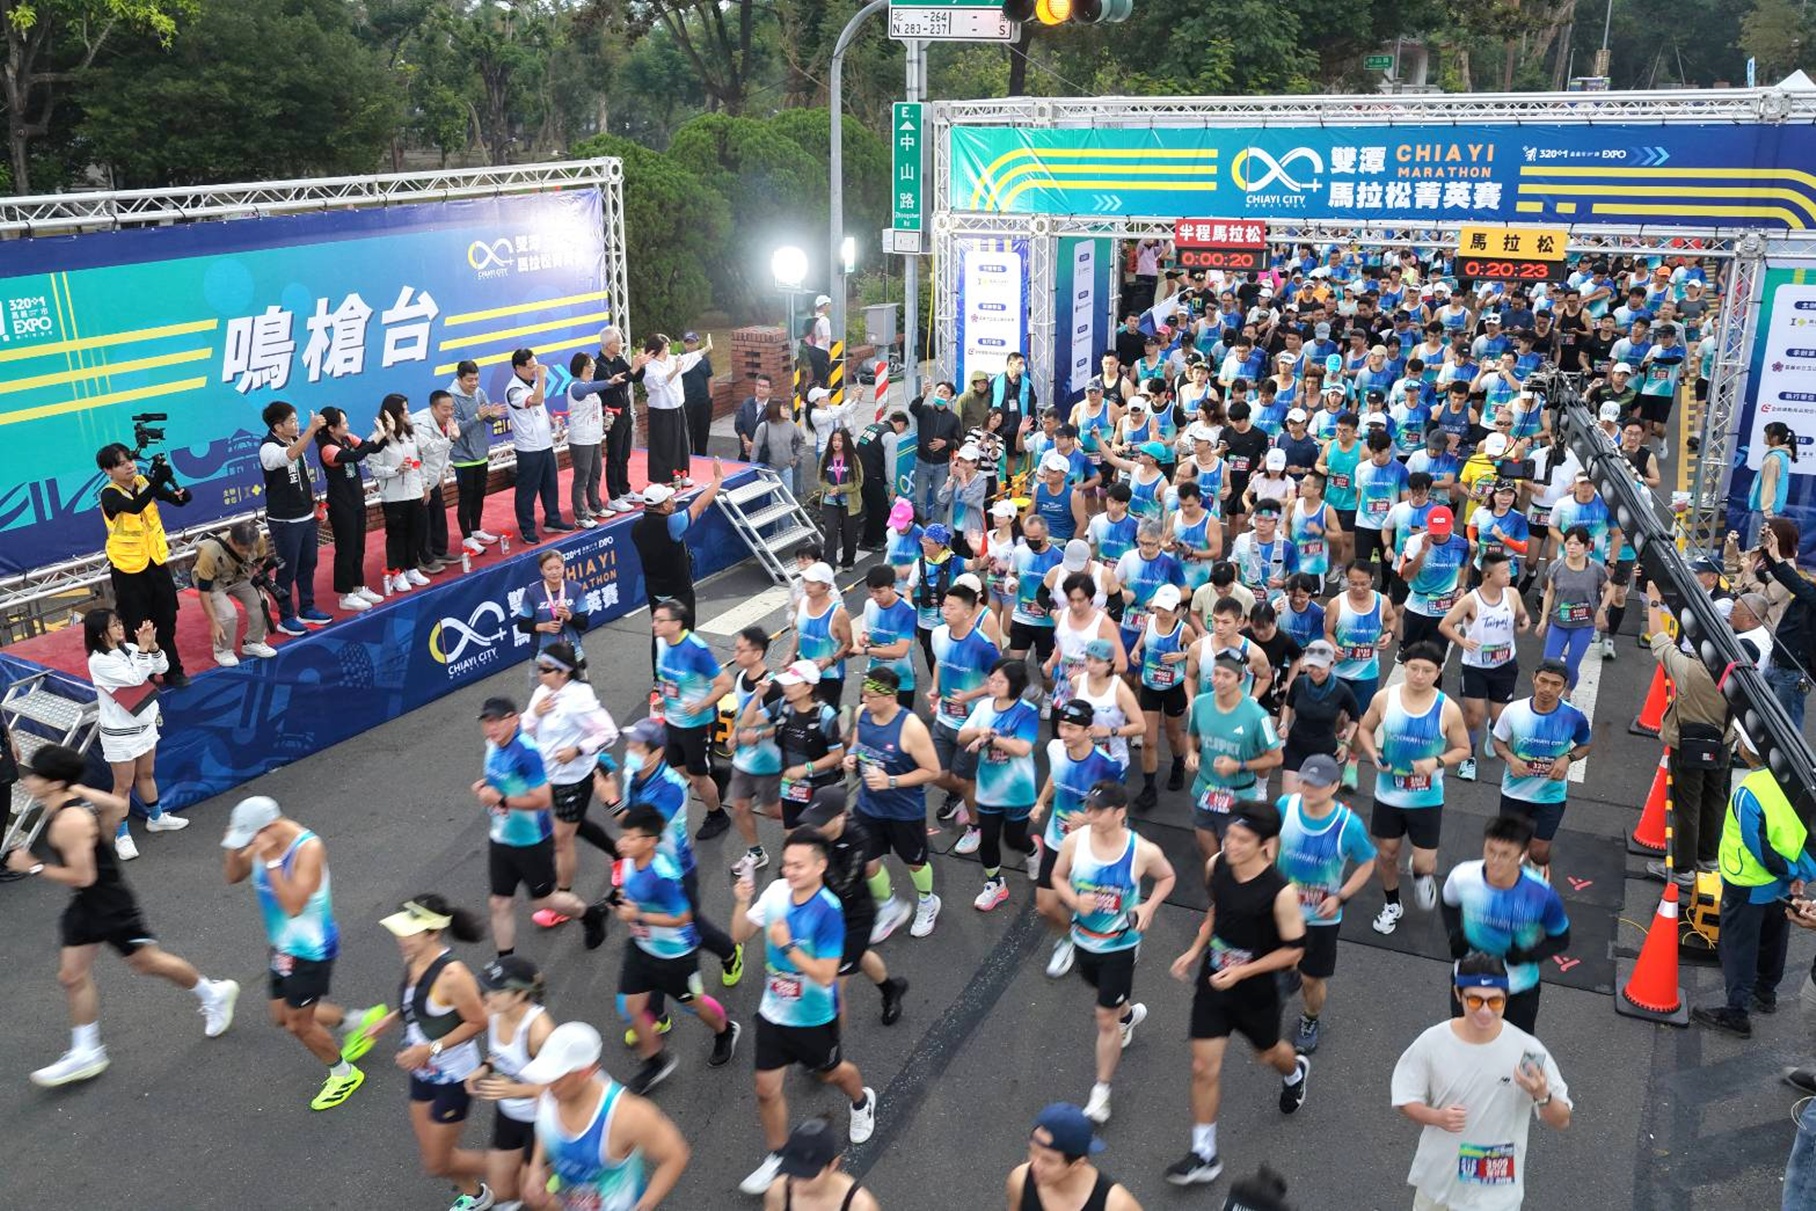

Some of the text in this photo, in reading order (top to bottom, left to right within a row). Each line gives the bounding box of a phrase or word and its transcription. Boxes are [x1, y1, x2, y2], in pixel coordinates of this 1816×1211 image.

[999, 25, 1009, 36] S.
[901, 106, 914, 118] E.
[1330, 146, 1387, 174] 雙潭
[1395, 144, 1495, 162] CHIAYI
[1602, 149, 1627, 159] EXPO
[900, 133, 915, 209] 中山路
[1398, 166, 1492, 178] MARATHON
[1246, 195, 1306, 204] CHIAYI CITY
[1328, 181, 1503, 210] 馬拉松菁英賽
[1179, 223, 1262, 242] 半程馬拉松
[1470, 233, 1555, 253] 馬拉松
[1182, 252, 1254, 268] 0:00:20
[1465, 261, 1549, 278] 0:20:23
[13, 316, 52, 334] EXPO
[221, 285, 440, 394] 鳴槍台
[566, 550, 616, 581] HIAYI
[448, 656, 477, 675] CHIAYI
[478, 648, 497, 662] CITY
